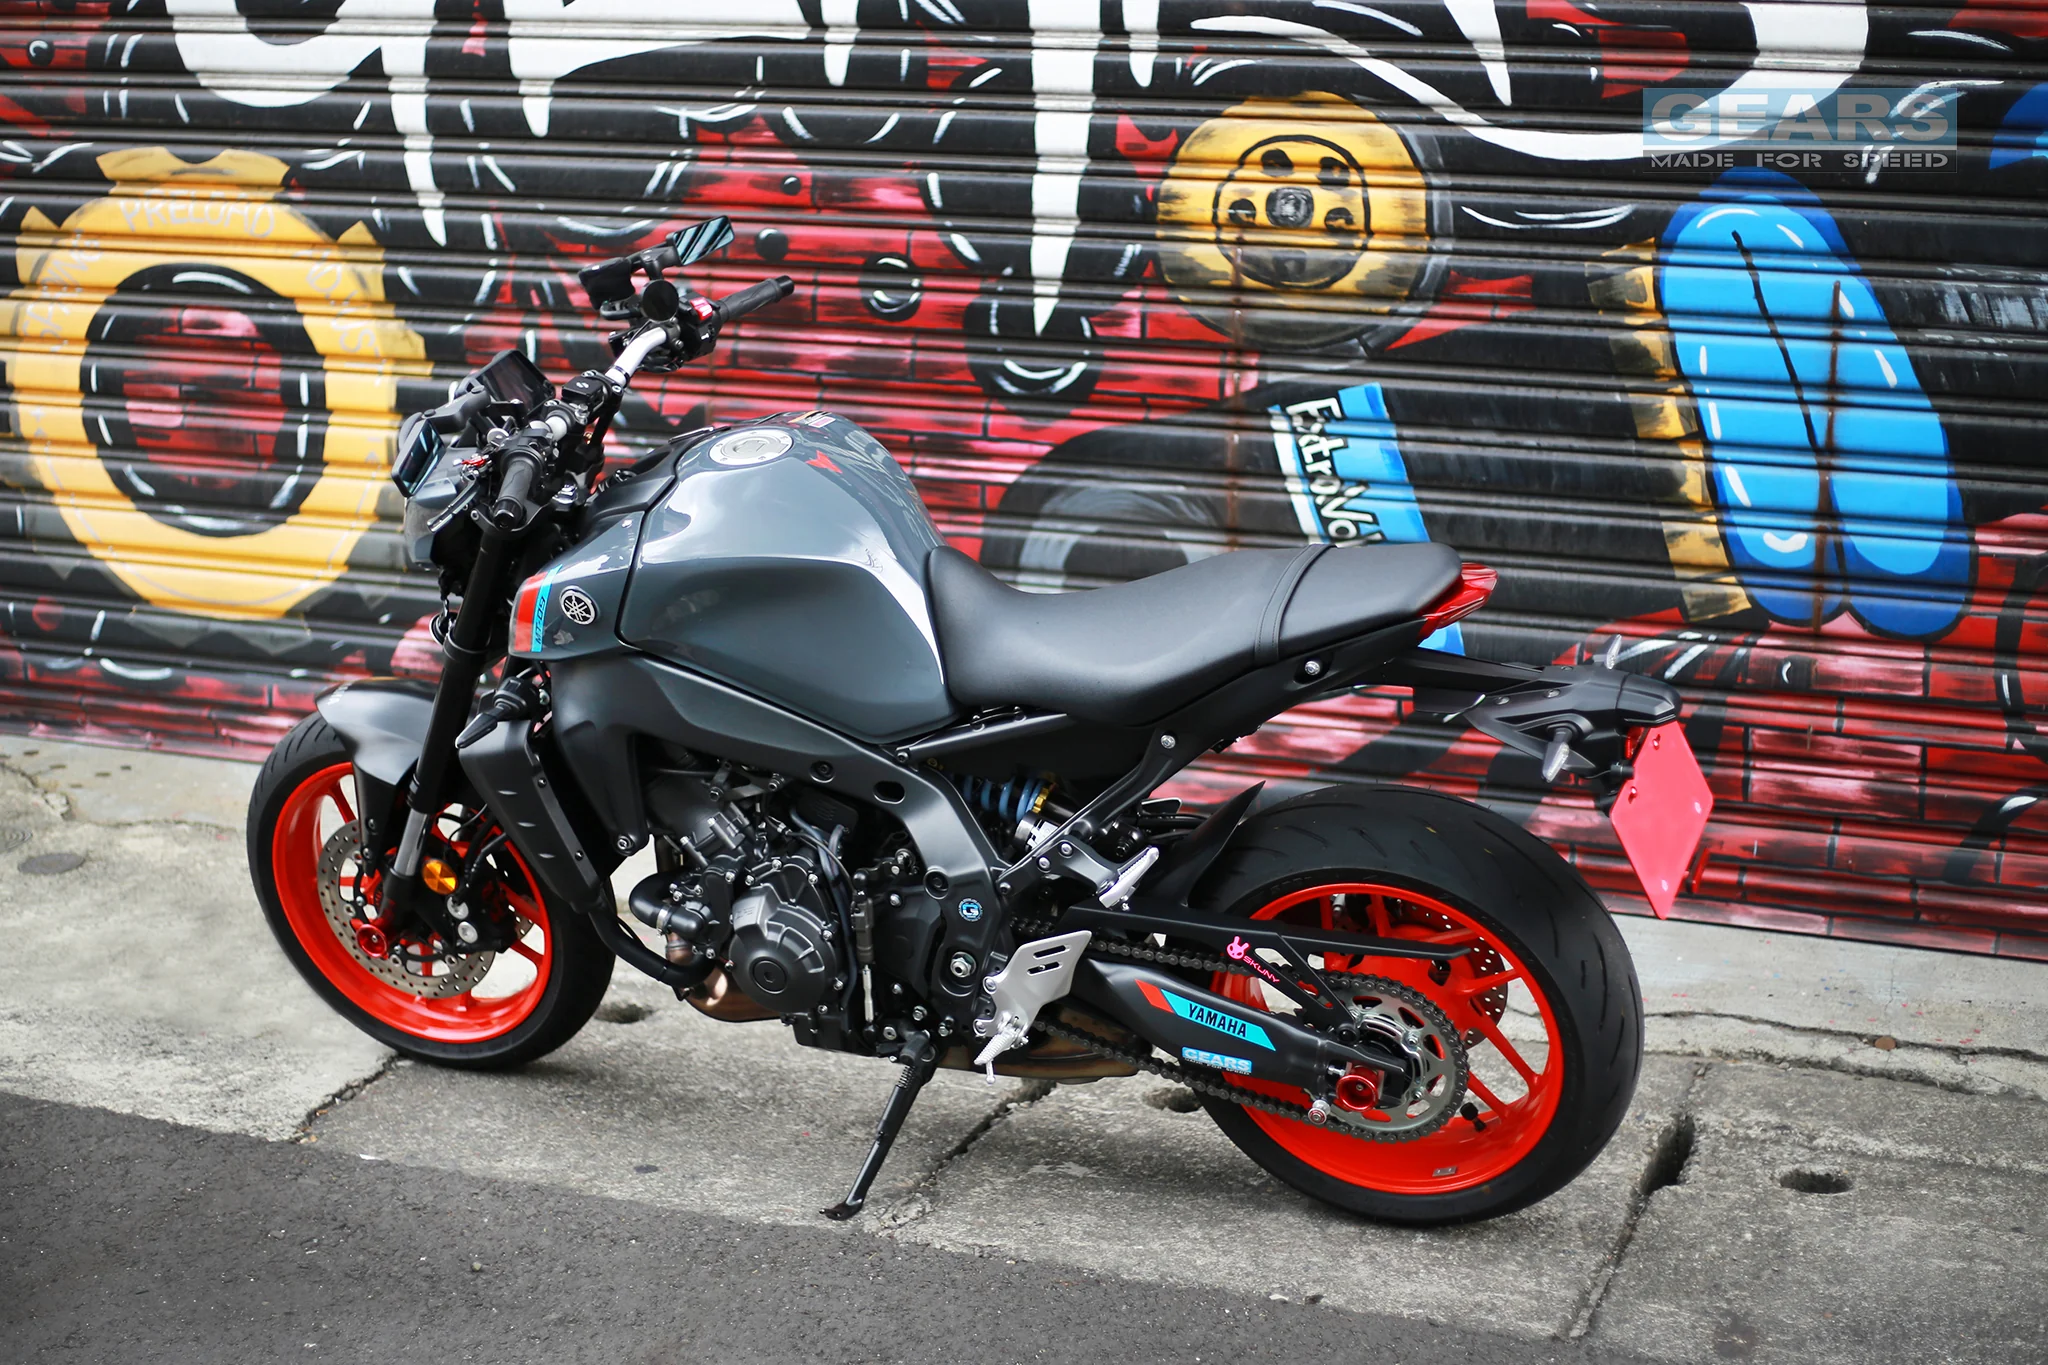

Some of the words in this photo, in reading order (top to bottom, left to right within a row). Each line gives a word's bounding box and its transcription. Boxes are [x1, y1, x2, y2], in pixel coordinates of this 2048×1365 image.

[119, 189, 275, 239] PRELOAD
[535, 596, 546, 645] MT-09
[1243, 955, 1280, 982] SKUNY
[1188, 1003, 1247, 1038] YAMAHA
[1184, 1048, 1249, 1071] GEARS
